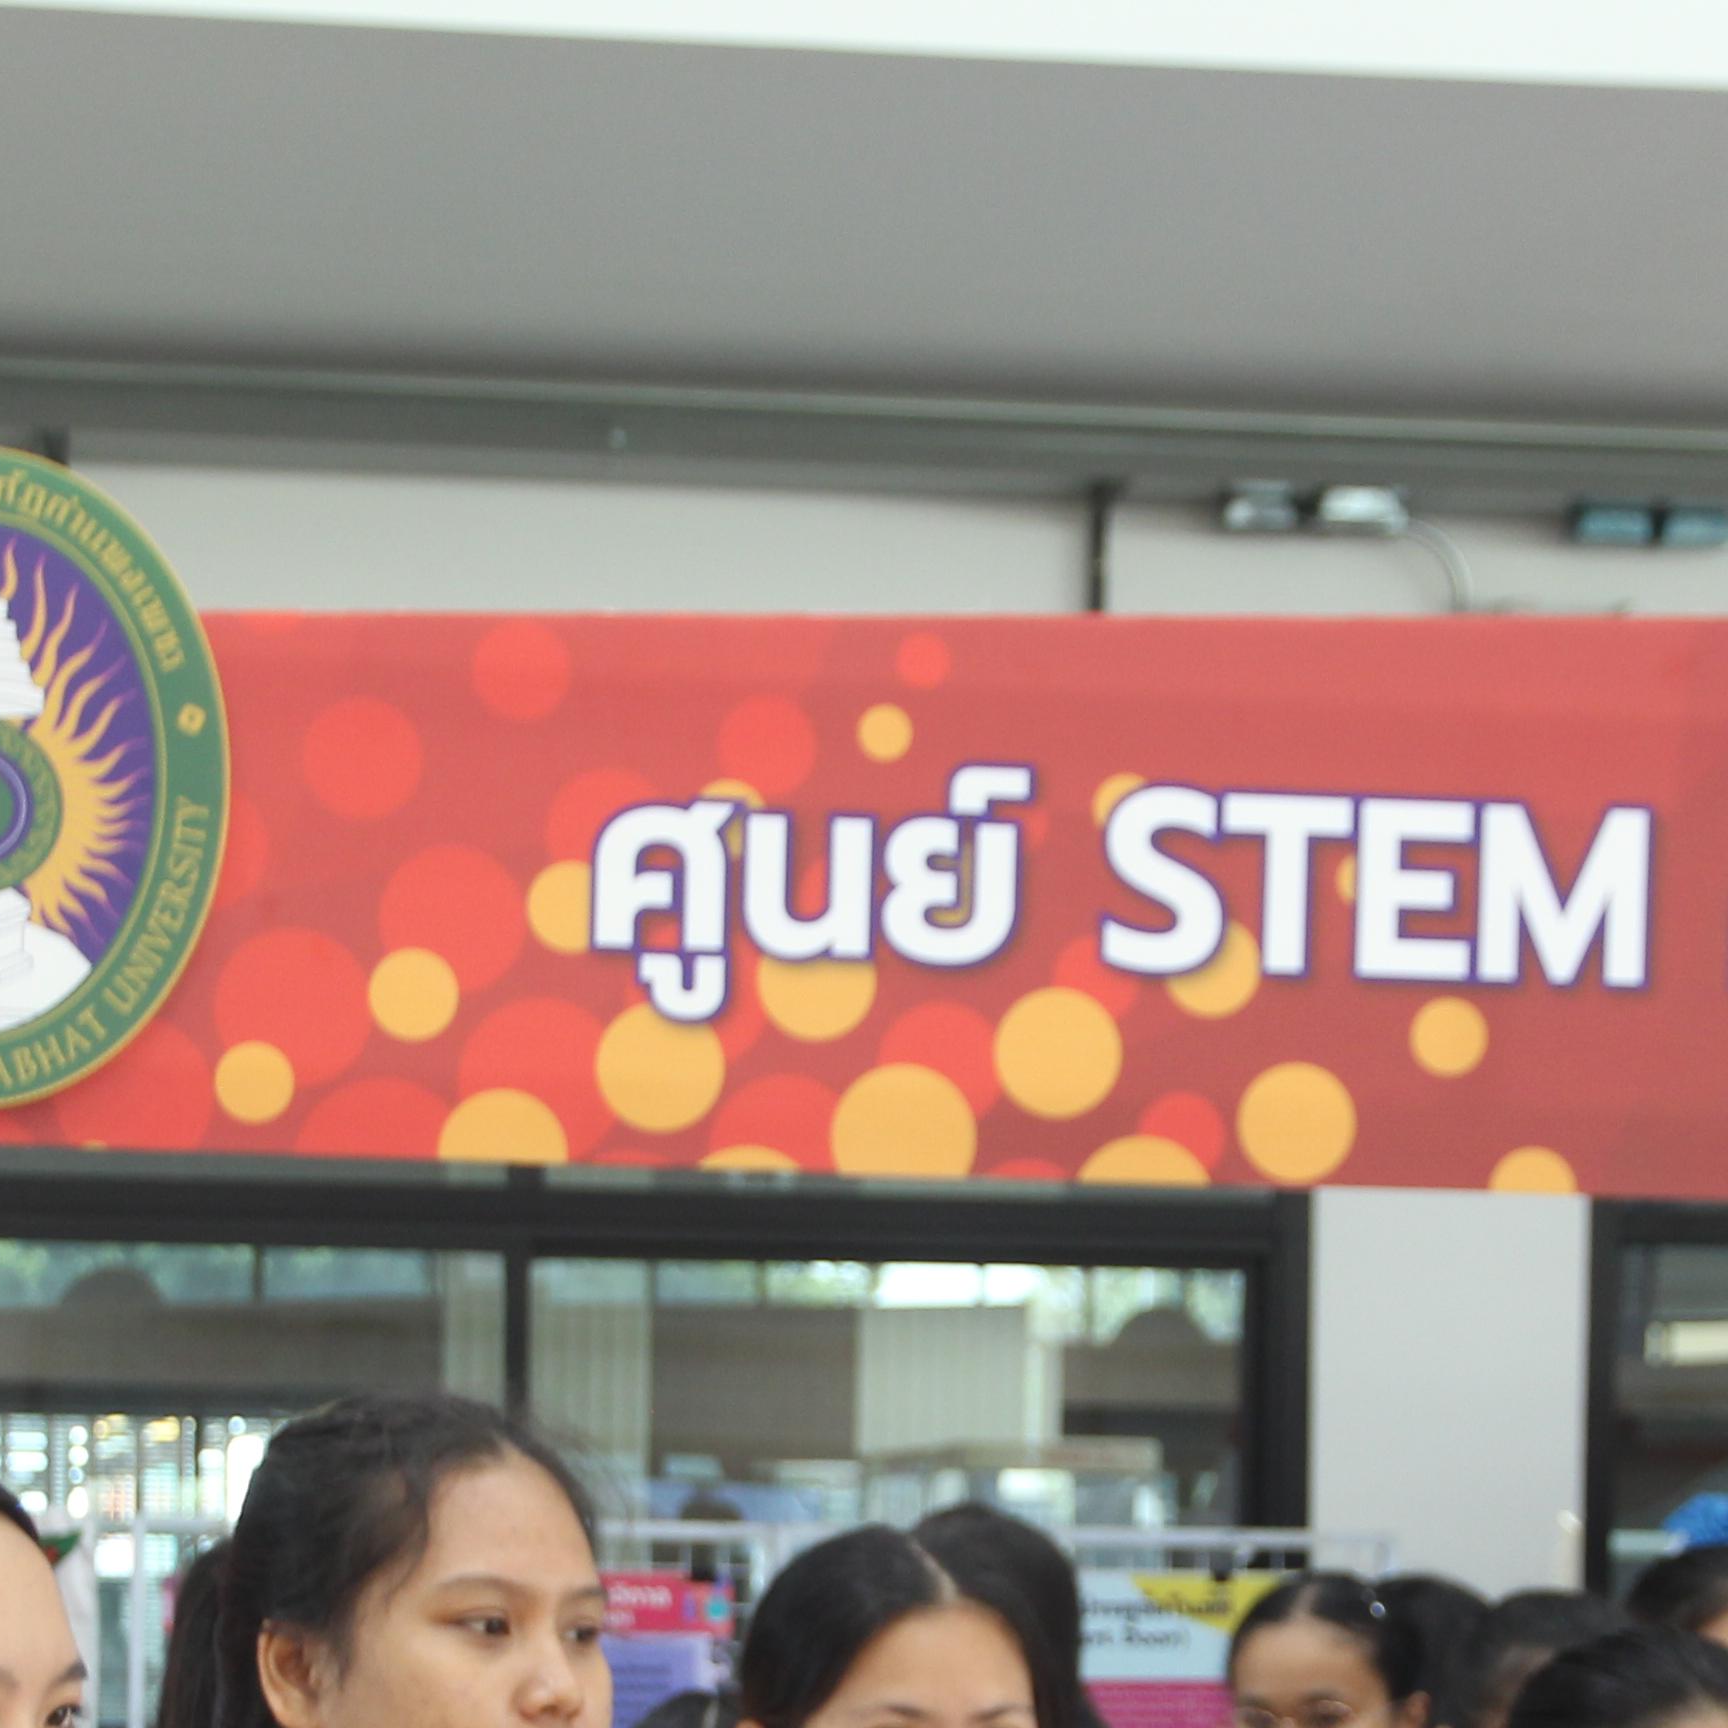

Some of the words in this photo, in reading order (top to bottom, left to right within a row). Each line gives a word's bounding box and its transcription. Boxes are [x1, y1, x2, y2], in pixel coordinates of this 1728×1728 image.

[100, 794, 211, 1017] UNIVERSITY
[591, 764, 1033, 1023] ศูนย์
[1099, 784, 1653, 989] STEM
